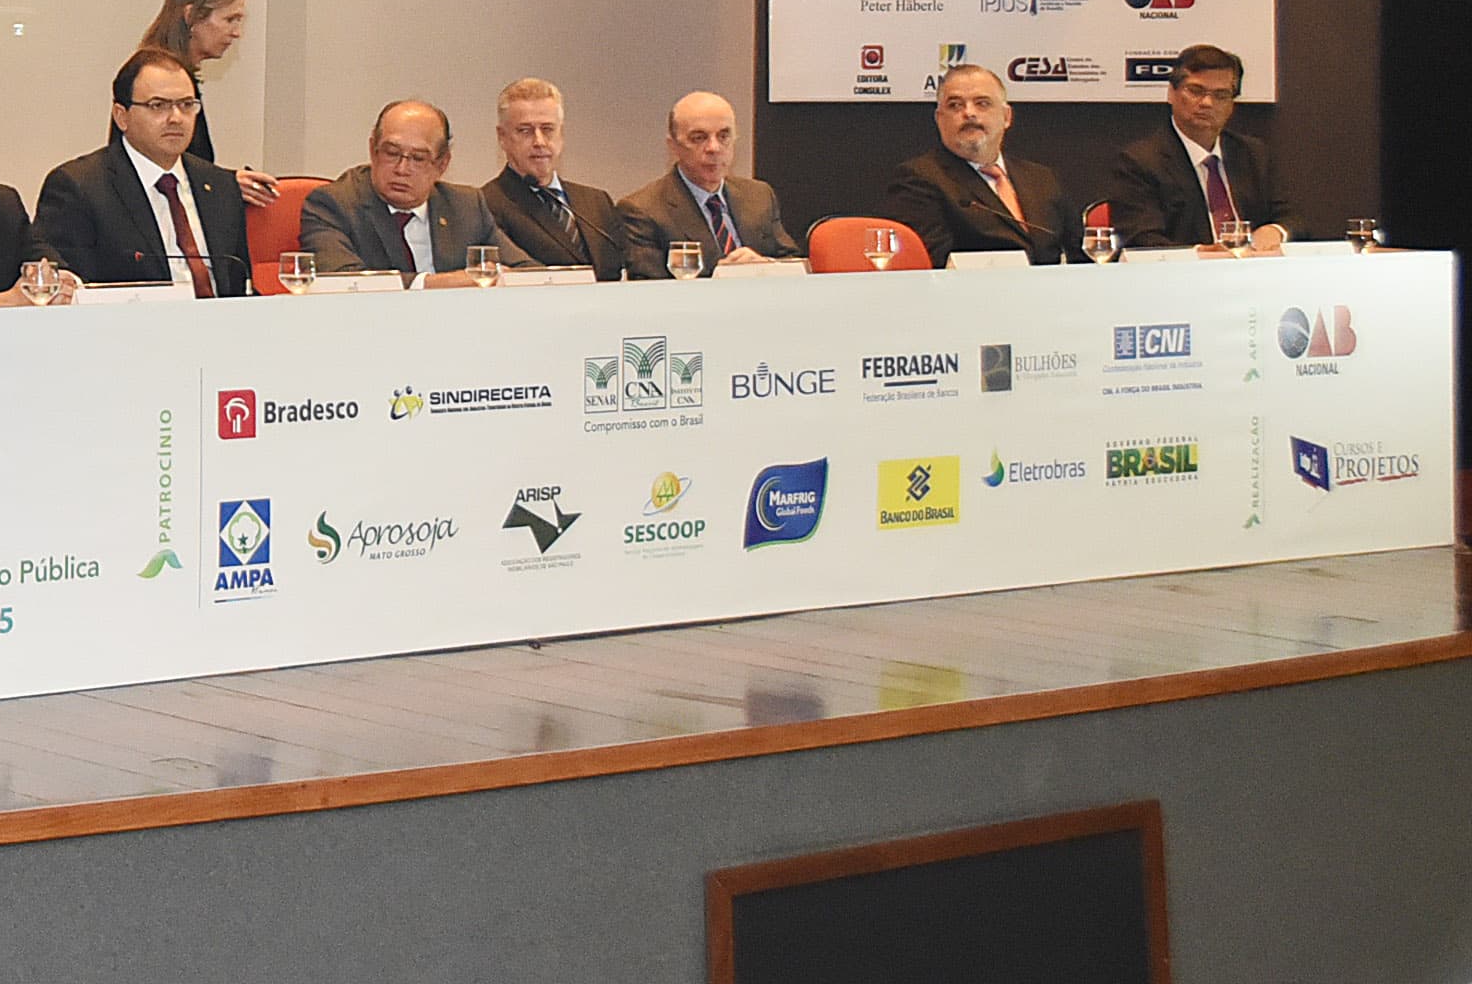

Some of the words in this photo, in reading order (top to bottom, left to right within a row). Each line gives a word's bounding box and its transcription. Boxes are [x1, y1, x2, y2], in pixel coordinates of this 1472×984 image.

[860, 0, 892, 13] Peter
[895, 0, 944, 12] Häberle
[1144, 327, 1185, 354] CNI
[862, 352, 959, 379] FEBRABAN
[1015, 351, 1077, 373] BULHÕES
[1295, 362, 1339, 376] NACIONAL
[429, 385, 552, 405] SINDIRECEITA
[624, 381, 664, 399] CNA
[263, 398, 359, 424] Bradesco
[584, 418, 647, 435] Compromisso
[649, 417, 669, 428] com
[670, 418, 678, 427] o
[679, 413, 704, 427] Brasil
[1333, 441, 1374, 457] CURSOS
[1008, 458, 1086, 483] Eletrobras
[1105, 443, 1198, 479] BRASIL
[1335, 453, 1420, 480] PROJETOS
[157, 409, 172, 543] PATROCÍNIO
[515, 485, 562, 502] ARISP
[769, 490, 816, 507] MARFRIG
[880, 509, 912, 525] BANCO
[912, 509, 924, 522] DO
[925, 505, 955, 521] BRASIL
[347, 517, 459, 558] Aprosoja
[624, 519, 705, 544] SESCOOP
[369, 550, 393, 561] MATO
[394, 547, 426, 559] GROSSO
[19, 553, 101, 585] Pública
[213, 567, 275, 591] AMPA
